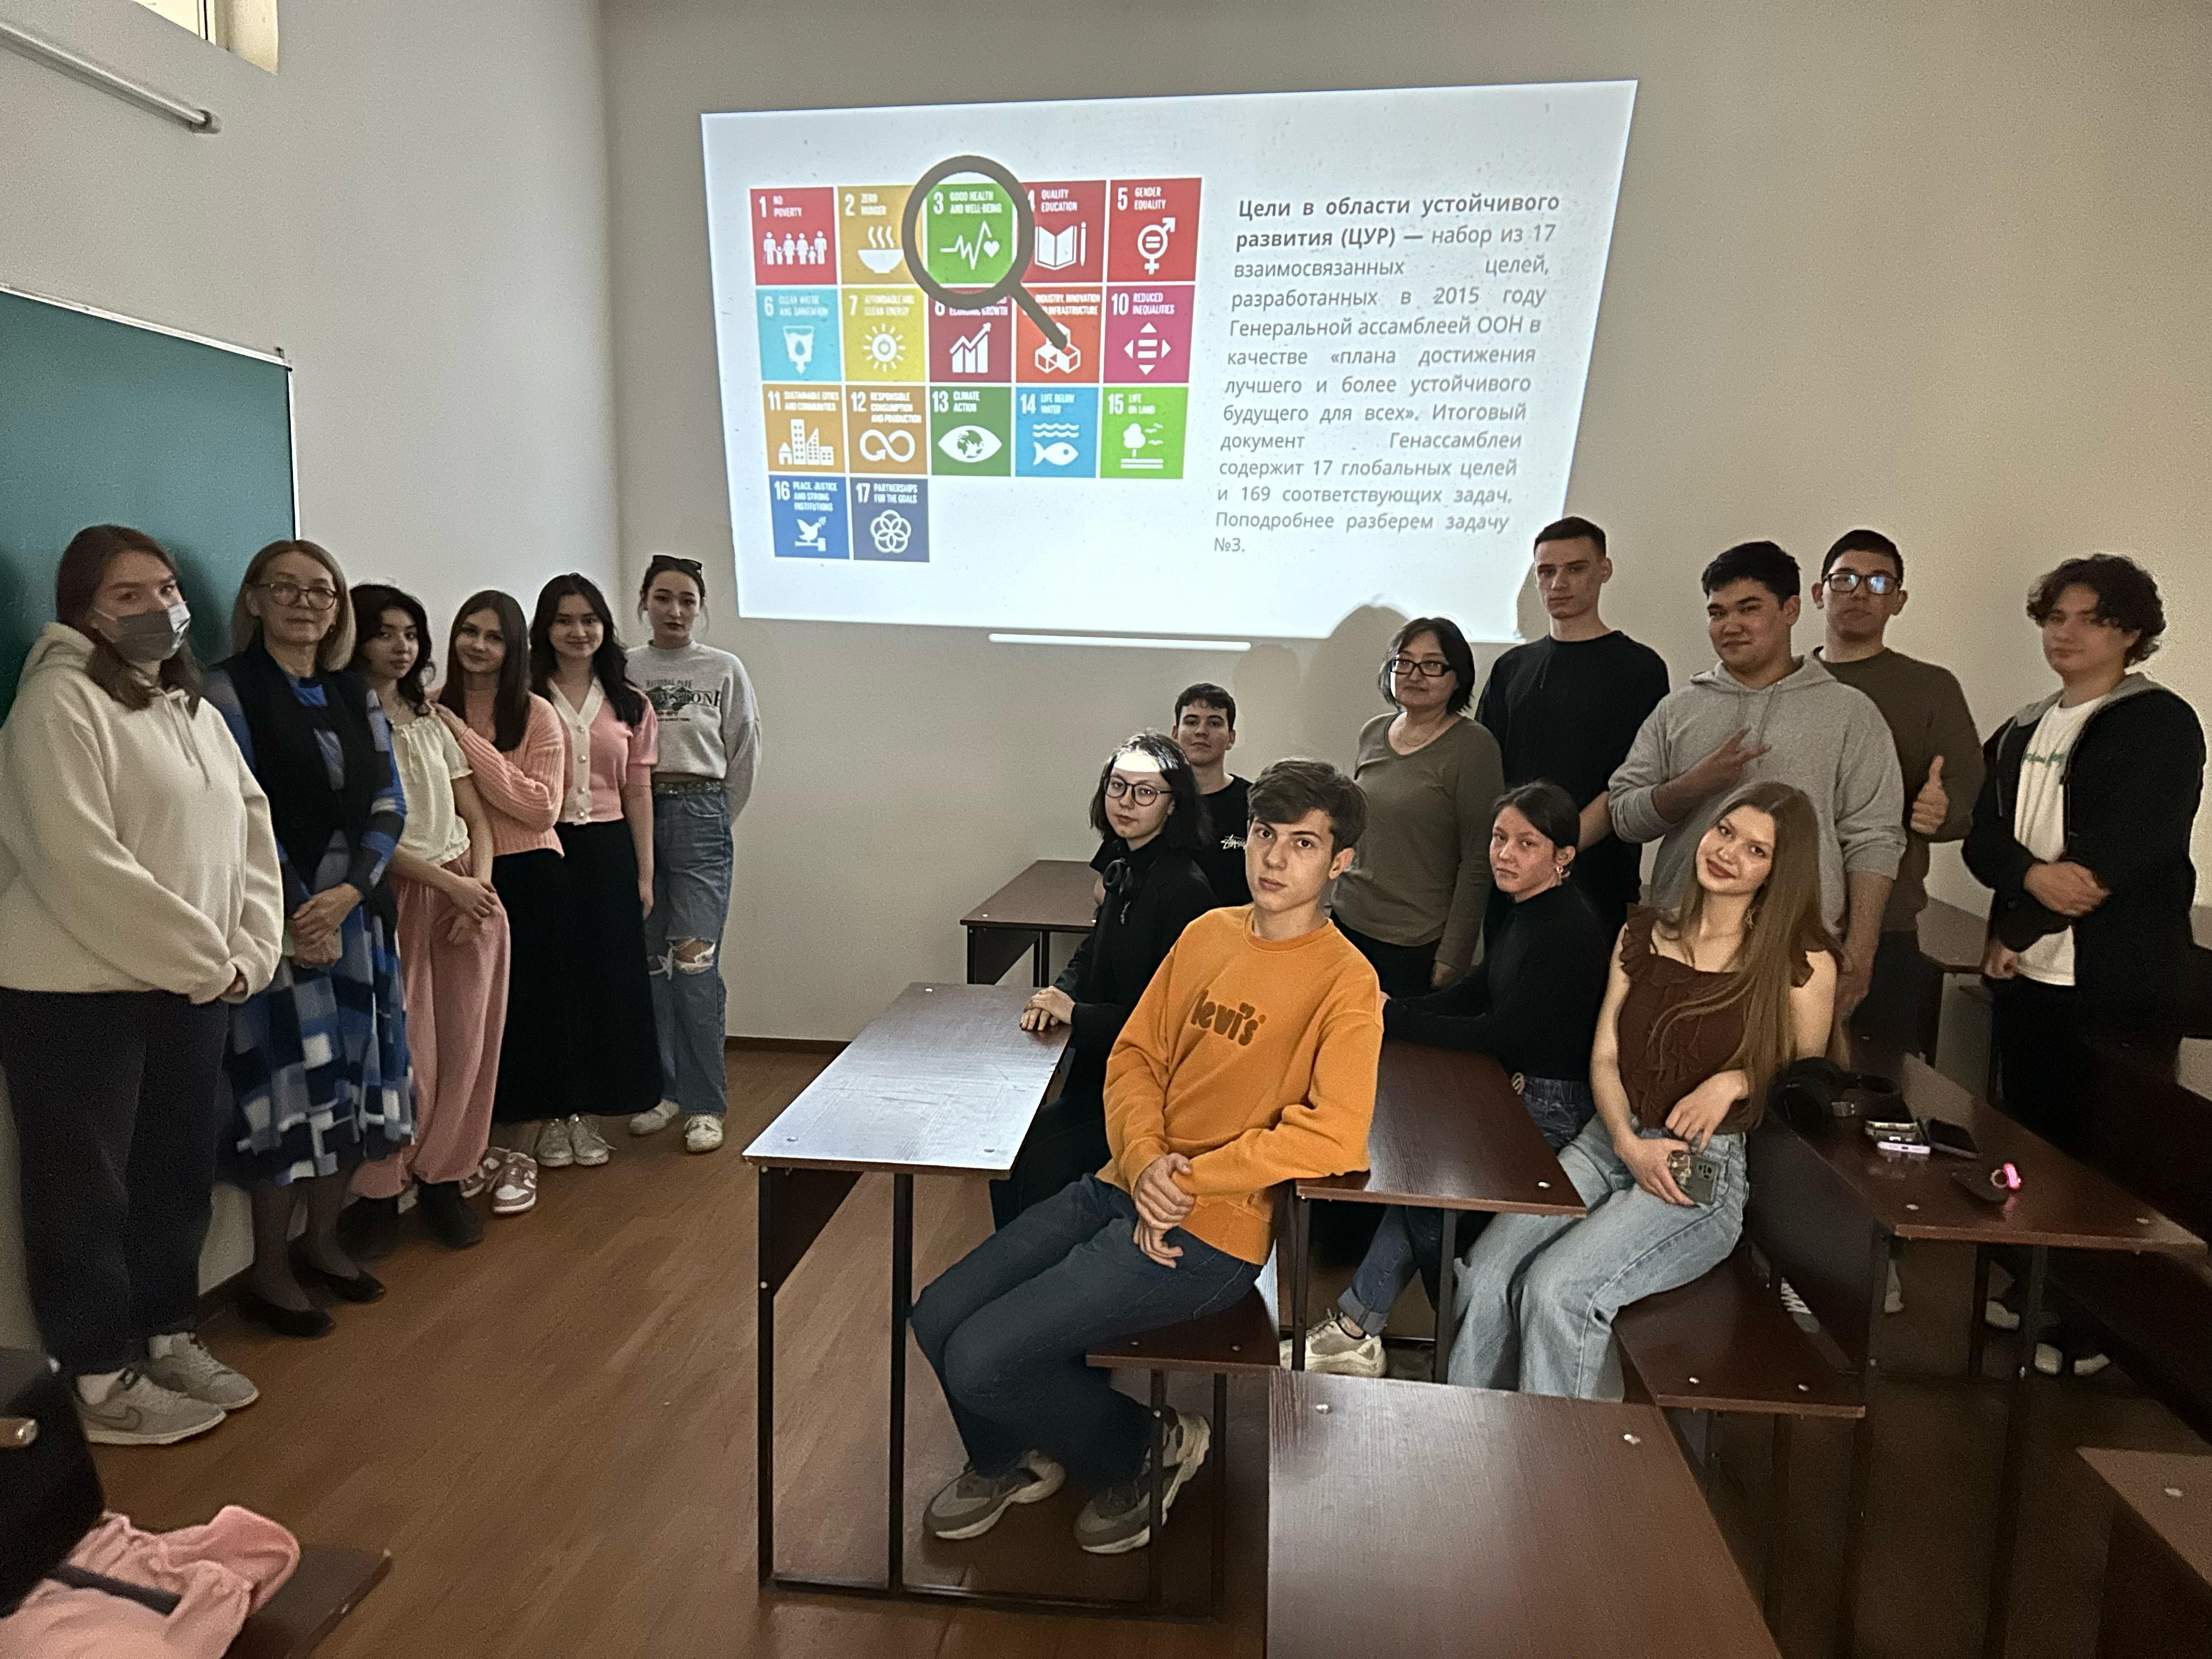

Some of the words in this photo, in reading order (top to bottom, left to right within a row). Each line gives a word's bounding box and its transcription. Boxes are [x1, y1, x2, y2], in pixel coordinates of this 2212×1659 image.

[1041, 189, 1069, 200] QUALITY
[1118, 187, 1128, 211] 5
[1135, 186, 1161, 198] GENDER
[759, 196, 767, 218] 1
[845, 194, 855, 216] 2
[933, 191, 944, 215] 3
[1041, 201, 1077, 212] EDUCATION
[1134, 199, 1166, 211] EQUALITY
[1239, 200, 1290, 221] Цели
[1303, 202, 1314, 216] в
[1326, 197, 1410, 215] области
[1421, 193, 1559, 218] устойчивого
[1236, 233, 1333, 252] развития
[1341, 227, 1395, 250] (ЦУР)
[1432, 225, 1492, 248] набор
[1501, 228, 1523, 242] из
[1534, 224, 1556, 241] 17
[1234, 262, 1404, 278] взаимосвязанных
[1486, 255, 1548, 277] целей,
[764, 295, 774, 317] 6
[849, 295, 857, 316] 7
[1111, 293, 1129, 315] 10
[1133, 292, 1164, 303] REDUCED
[1232, 289, 1378, 312] разработанных
[1401, 291, 1411, 304] в
[1433, 286, 1479, 304] 2015
[1503, 290, 1547, 308] году
[1132, 304, 1175, 315] INEQUALITIES
[1231, 318, 1352, 341] Генеральной
[1358, 316, 1470, 335] ассамблеей
[1477, 315, 1523, 333] ООН
[1530, 319, 1541, 333] в
[1228, 352, 1307, 365] качестве
[1331, 351, 1396, 364] «плана
[1418, 349, 1535, 367] достижения
[953, 391, 980, 401] CLIMATE
[1224, 380, 1302, 398] лучшего
[1316, 381, 1327, 393] и
[1342, 376, 1396, 393] более
[1409, 375, 1531, 397] устойчивого
[768, 391, 781, 411] 11
[850, 391, 867, 412] 12
[932, 390, 949, 413] 13
[953, 403, 977, 412] ACTION
[1020, 393, 1036, 414] 14
[1041, 393, 1053, 403] LIFE
[1108, 393, 1124, 414] 15
[1224, 404, 1308, 426] будущего
[1319, 409, 1352, 424] для
[1365, 408, 1419, 421] всех».
[1432, 403, 1526, 420] Итоговый
[1220, 436, 1305, 453] документ
[1390, 431, 1521, 448] Генассамблеи
[1220, 463, 1304, 479] содержит
[1314, 460, 1333, 475] 17
[1341, 459, 1452, 476] глобальных
[1460, 459, 1516, 478] целей
[774, 481, 791, 500] 16
[814, 482, 838, 491] JUSTICE
[856, 483, 870, 503] 17
[873, 483, 918, 493] PARTNERSHIPS
[1218, 489, 1227, 500] и
[1242, 486, 1270, 501] 169
[1283, 490, 1442, 507] соответствующих
[1454, 490, 1511, 505] задач.
[874, 493, 885, 503] FOR
[887, 493, 898, 504] THE
[898, 494, 917, 504] GOALS
[1216, 512, 1334, 531] Поподробнее
[1346, 513, 1433, 533] разберем
[1446, 516, 1509, 534] задачу
[1214, 538, 1245, 552] №3.
